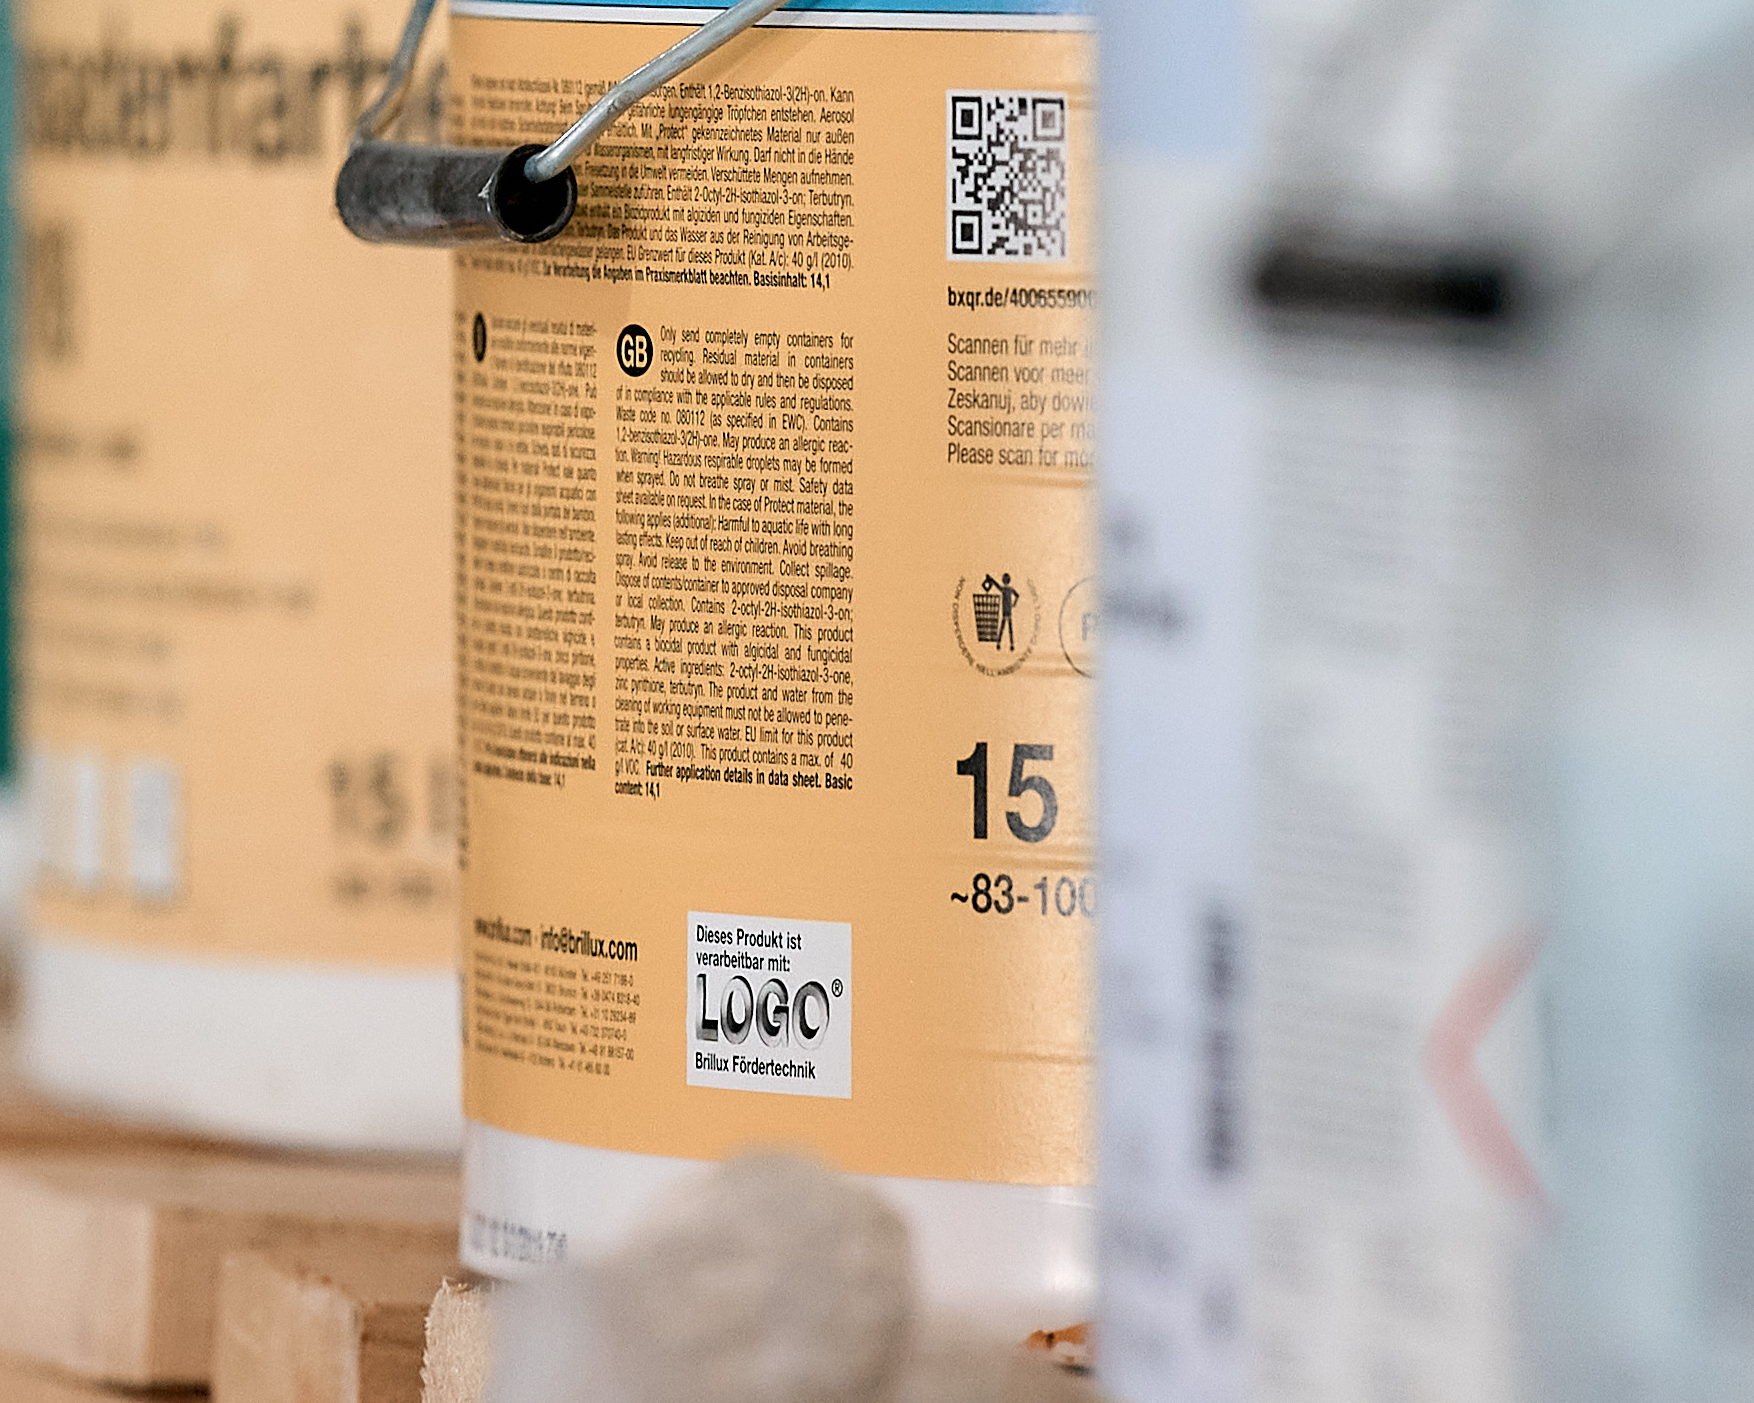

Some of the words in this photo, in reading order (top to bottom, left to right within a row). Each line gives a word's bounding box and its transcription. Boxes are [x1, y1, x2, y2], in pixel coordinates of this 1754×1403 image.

[708, 83, 828, 106] 1,2-Benzisothiazol-3(2H)-on.
[830, 87, 854, 102] Kann
[727, 104, 767, 125] Tröpfchen
[771, 106, 816, 122] entstehen.
[820, 107, 854, 123] Aerosol
[692, 124, 762, 145] gekennzeichnetes
[767, 126, 801, 142] Material
[806, 131, 821, 143] nur
[825, 128, 854, 144] außen
[670, 143, 714, 164] langfristiger
[716, 145, 751, 165] Wirkung.
[754, 147, 771, 162] Darf
[774, 147, 795, 163] nicht
[798, 148, 806, 163] in
[808, 148, 822, 164] die
[824, 149, 854, 164] Hände
[669, 164, 708, 181] vermeiden.
[711, 166, 761, 183] Verschüttete
[764, 168, 798, 187] Mengen
[800, 169, 854, 185] aufnehmen.
[667, 185, 692, 201] Enthält
[809, 190, 854, 210] Terbutryn.
[673, 206, 684, 221] mit
[687, 206, 721, 226] algiziden
[723, 208, 739, 223] und
[742, 208, 784, 228] fungiziden
[788, 210, 854, 230] Eigenschaften.
[649, 225, 663, 241] und
[665, 226, 677, 241] das
[680, 227, 707, 243] Wasser
[709, 232, 724, 243] aus
[727, 228, 740, 244] der
[743, 229, 784, 249] Reinigung
[788, 234, 804, 246] von
[807, 231, 853, 251] Arbeitsge-
[627, 245, 637, 260] EU
[676, 247, 685, 262] für
[688, 248, 712, 263] dieses
[715, 249, 746, 265] Produkt
[791, 251, 803, 266] 40
[807, 252, 818, 271] g/l
[821, 252, 854, 272] (2010).
[646, 267, 707, 284] Praxismerkblatt
[710, 269, 751, 286] beachten.
[753, 271, 807, 287] Basisinhalt:
[810, 272, 830, 292] 14,1
[705, 327, 748, 347] completely
[755, 329, 780, 348] empty
[787, 330, 833, 347] containers
[841, 332, 853, 347] for
[948, 332, 1008, 354] Scannen
[1014, 334, 1033, 355] für
[1040, 336, 1077, 356] mehr
[621, 334, 647, 368] GB
[703, 347, 736, 365] Residual
[745, 349, 779, 366] material
[805, 352, 853, 368] containers
[777, 372, 795, 388] then
[813, 373, 853, 393] disposed
[948, 360, 1009, 382] Scannen
[1014, 366, 1044, 383] voor
[756, 392, 776, 408] rules
[780, 393, 796, 409] and
[801, 394, 853, 414] regulations.
[948, 387, 1016, 414] Zeskanuj,
[1021, 391, 1046, 415] aby
[727, 411, 763, 432] specified
[814, 415, 853, 432] Contains
[948, 414, 1034, 437] Scansionare
[1041, 422, 1065, 443] per
[723, 432, 739, 452] May
[743, 433, 775, 453] produce
[793, 435, 824, 455] allergic
[948, 442, 993, 464] Please
[999, 448, 1033, 465] scan
[1039, 446, 1057, 466] for
[746, 454, 780, 474] droplets
[820, 457, 853, 474] formed
[734, 478, 755, 494] spray
[800, 478, 827, 497] Safety
[833, 479, 853, 495] data
[764, 497, 794, 514] Protect
[718, 516, 749, 533] Harmful
[812, 520, 830, 536] with
[833, 521, 853, 540] long
[745, 538, 780, 555] children.
[783, 540, 807, 556] Avoid
[810, 541, 853, 561] breathing
[779, 561, 809, 578] Collect
[815, 562, 853, 582] spillage.
[772, 581, 808, 602] disposal
[811, 587, 853, 603] company
[794, 624, 812, 641] This
[818, 625, 853, 645] product
[807, 646, 852, 666] fungicidal
[812, 688, 833, 705] from
[777, 708, 811, 725] allowed
[817, 731, 853, 750] product
[646, 760, 673, 778] Further
[676, 763, 720, 785] application
[724, 767, 752, 785] details
[768, 770, 789, 787] data
[792, 771, 821, 788] sheet.
[825, 773, 853, 790] Basic
[957, 742, 1058, 843] 15
[696, 925, 733, 944] Dieses
[737, 928, 783, 948] Produkt
[787, 932, 802, 950] ist
[696, 950, 764, 970] verarbeitbar
[768, 954, 790, 972] mit:
[696, 1052, 729, 1072] Brillux
[733, 1055, 816, 1079] Fördertechnik
